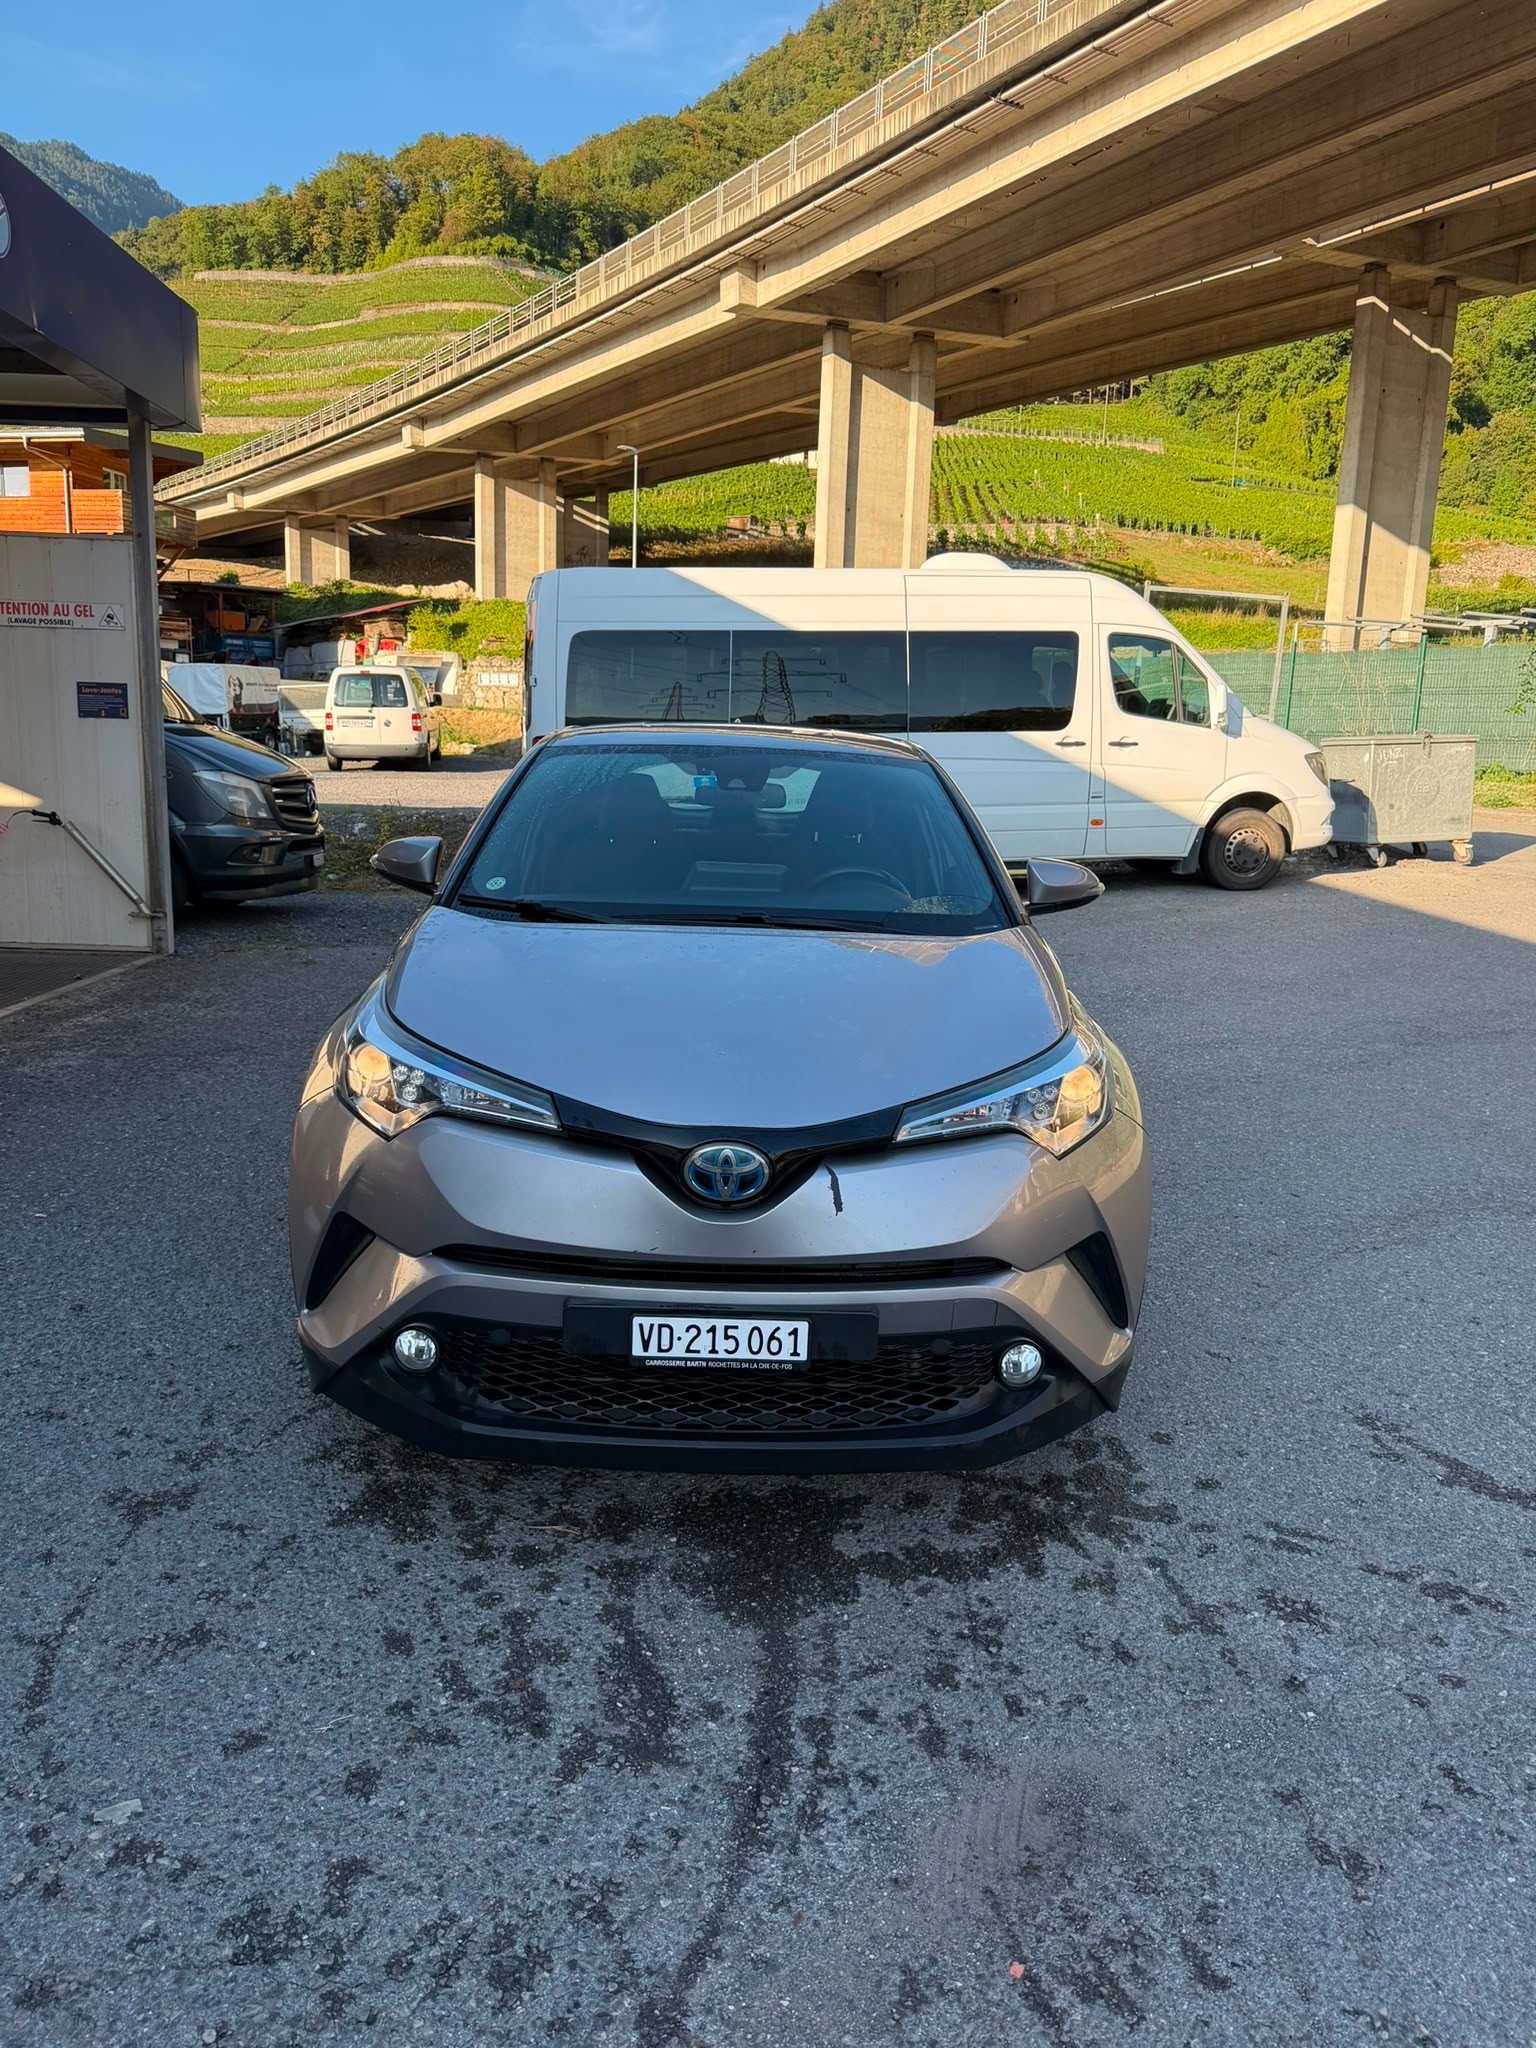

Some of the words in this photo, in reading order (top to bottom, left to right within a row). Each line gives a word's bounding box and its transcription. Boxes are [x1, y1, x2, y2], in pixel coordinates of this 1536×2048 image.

[53, 603, 70, 617] AU
[74, 604, 95, 618] GEL
[7, 617, 37, 625] (LAVAGE
[38, 618, 74, 627] POSSIBLE)
[645, 1359, 686, 1367] CARROSSERIE
[708, 1361, 741, 1369] ROCHETTES
